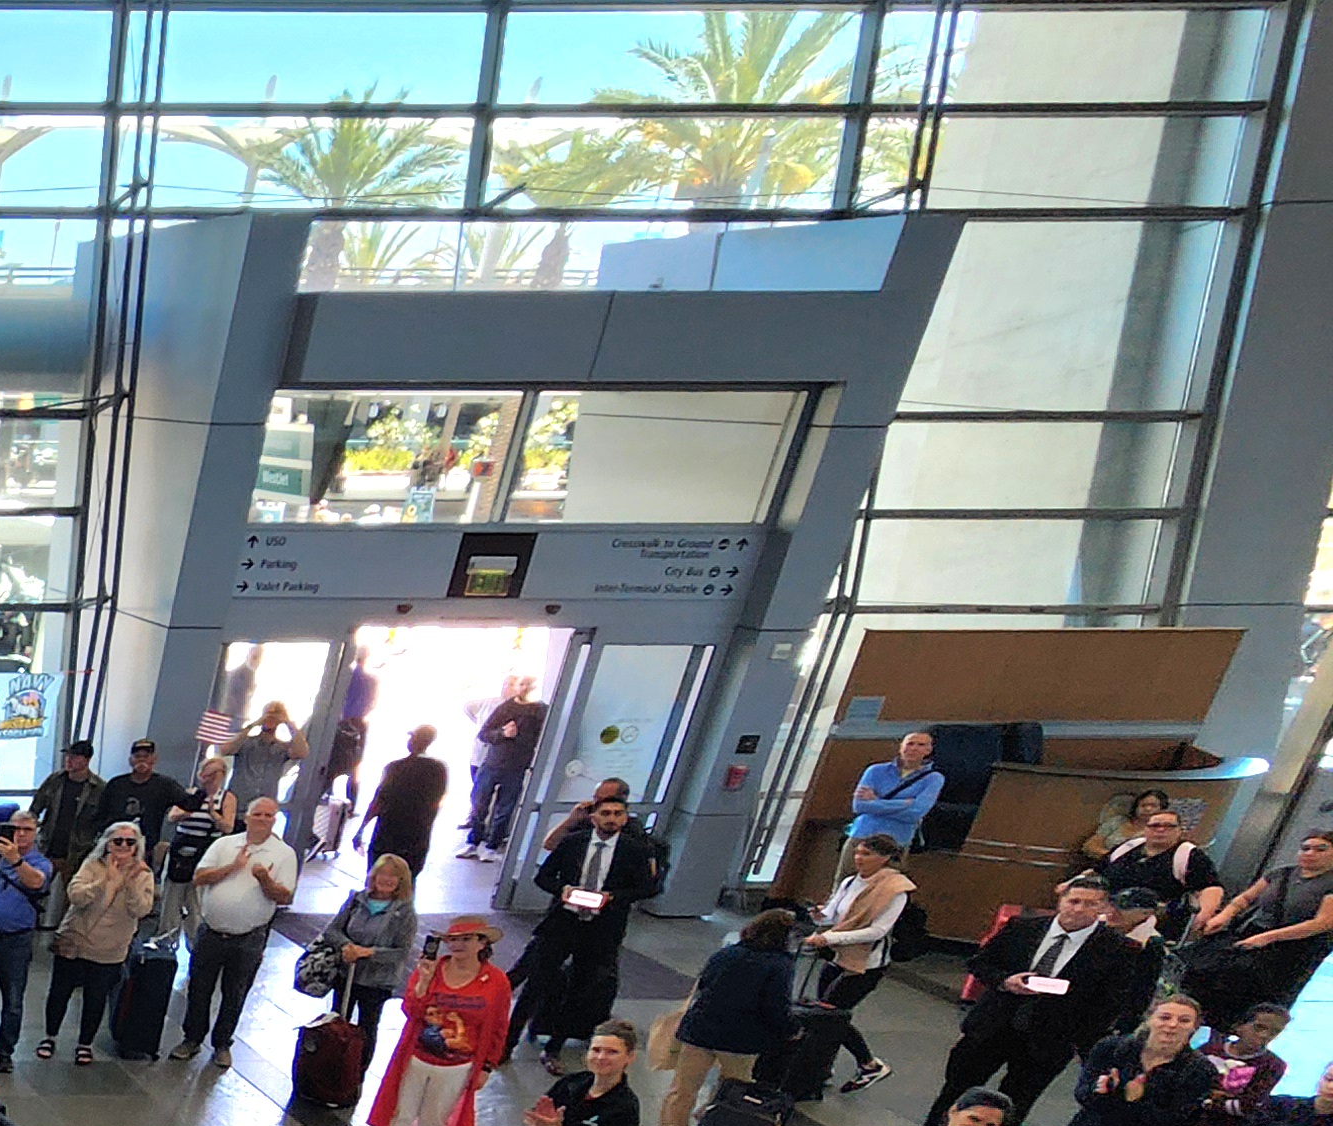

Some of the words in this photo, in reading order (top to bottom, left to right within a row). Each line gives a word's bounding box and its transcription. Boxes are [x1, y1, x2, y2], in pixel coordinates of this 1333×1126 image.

[664, 539, 676, 549] to
[639, 549, 710, 560] Transportation
[260, 559, 298, 571] Parking
[664, 566, 684, 578] City
[685, 567, 704, 577] Bus
[255, 581, 281, 592] Valet
[282, 582, 320, 594] Parking
[664, 583, 698, 594] Shuttle
